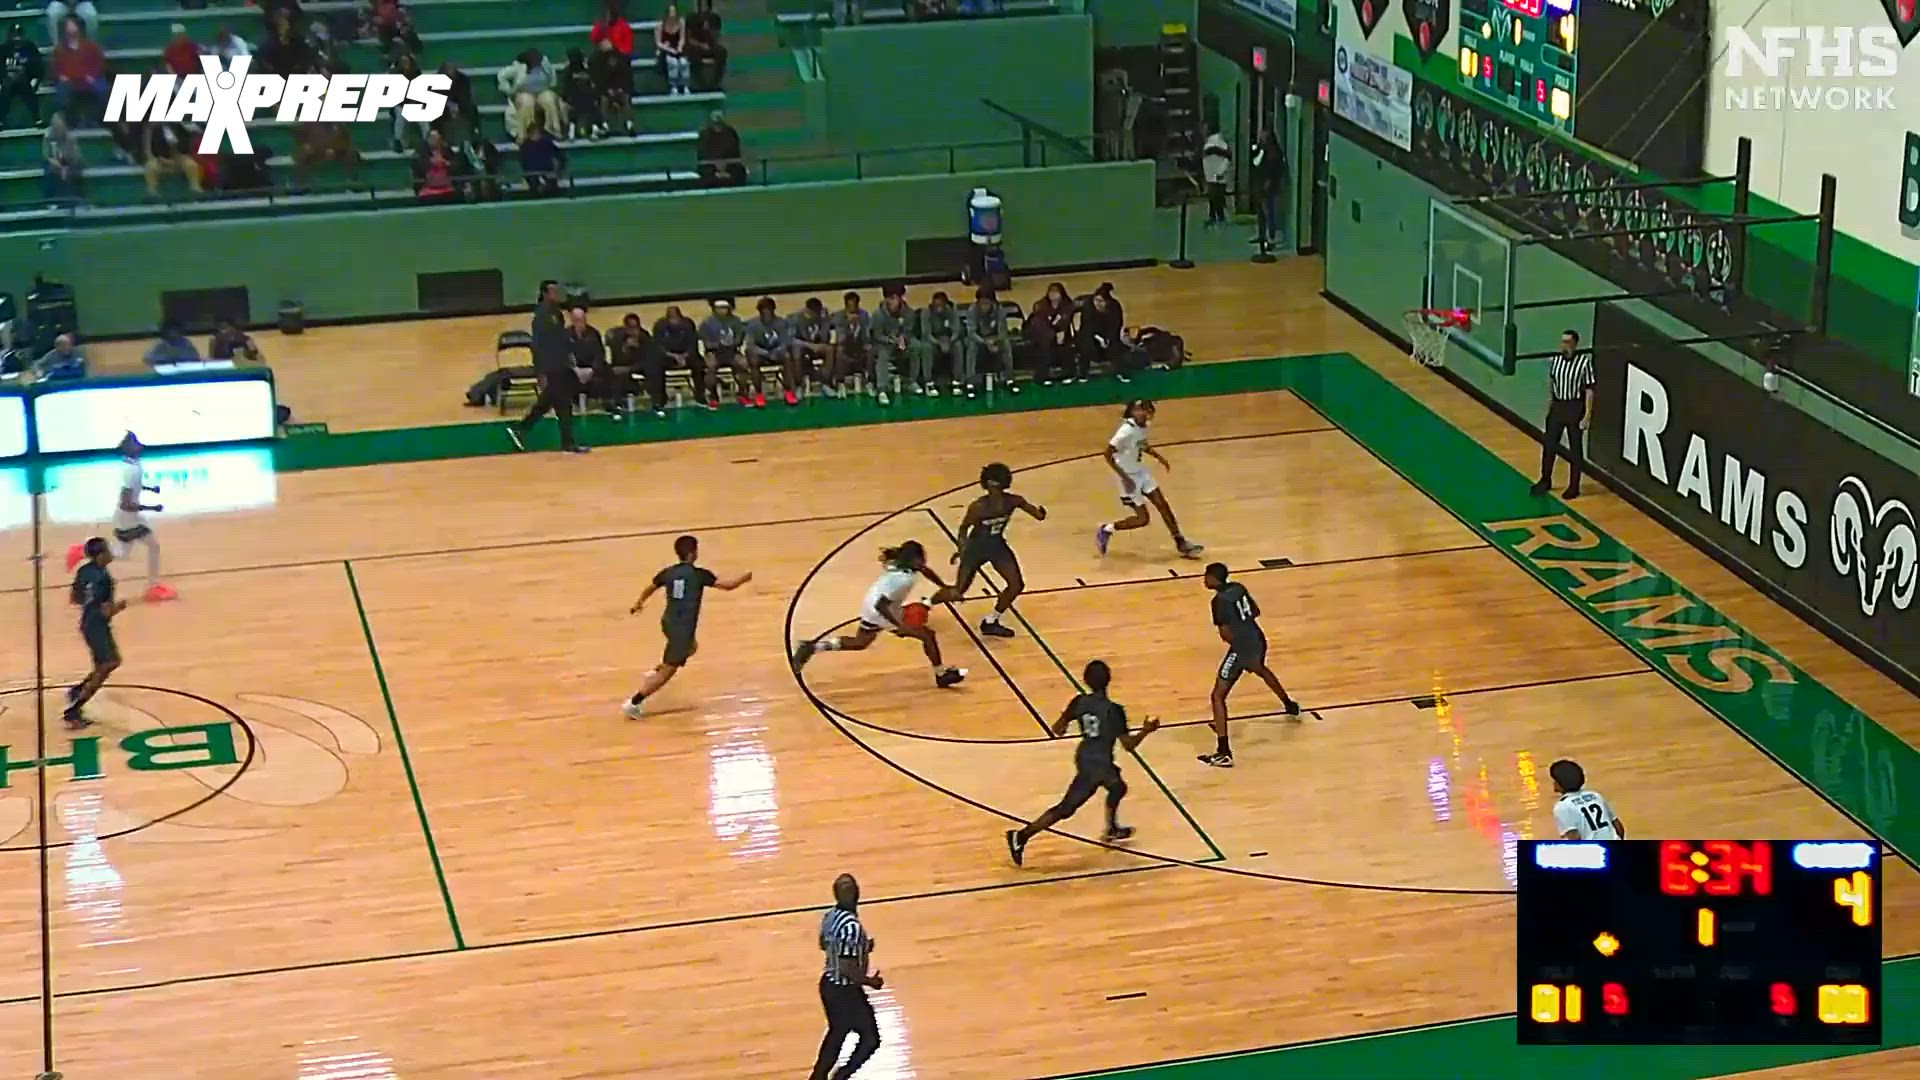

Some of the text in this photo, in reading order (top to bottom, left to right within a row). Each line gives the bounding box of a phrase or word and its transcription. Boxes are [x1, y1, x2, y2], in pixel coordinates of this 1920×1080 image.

[1622, 363, 1808, 568] RAMS
[1236, 595, 1252, 621] 14
[1483, 514, 1799, 693] RAMS
[1581, 804, 1609, 830] 12
